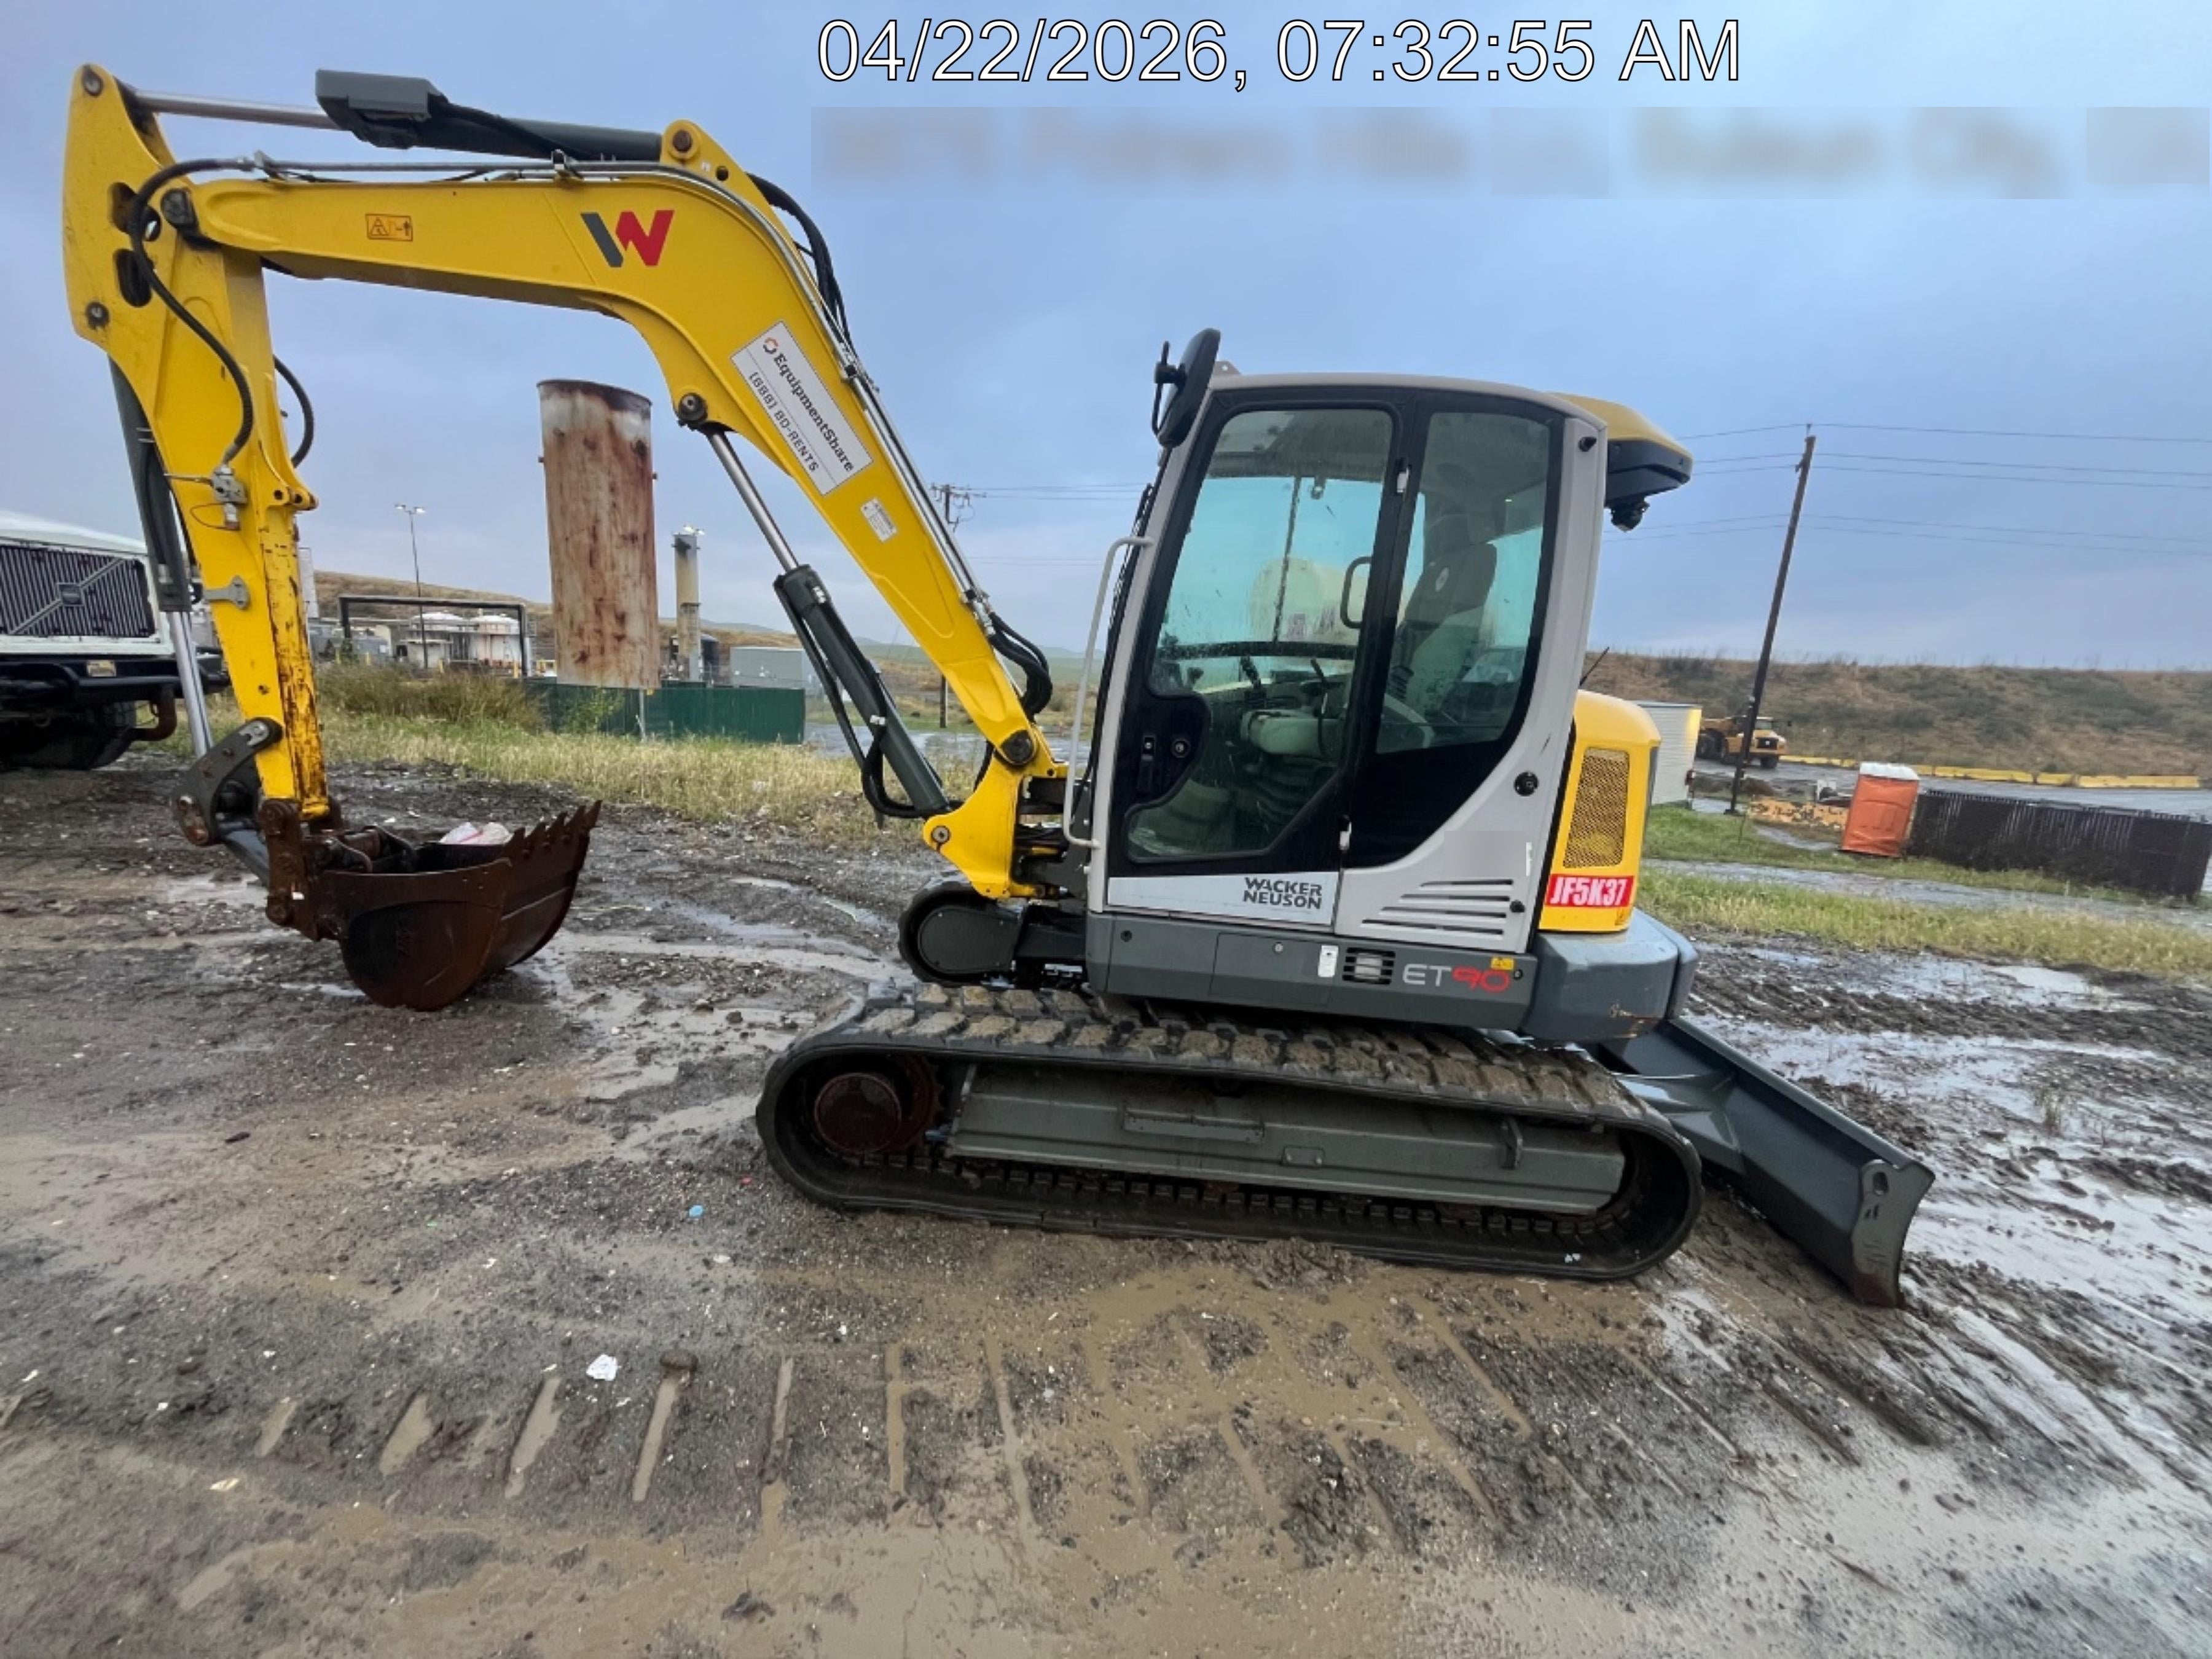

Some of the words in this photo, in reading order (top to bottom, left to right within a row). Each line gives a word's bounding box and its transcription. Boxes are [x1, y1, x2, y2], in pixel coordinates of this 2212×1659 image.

[773, 353, 854, 472] EquipmentShare
[774, 410, 819, 471] 80-RENTS
[1243, 890, 1322, 909] NEUSON
[1244, 876, 1322, 896] WACKER
[1550, 876, 1628, 906] JF5K37
[1402, 963, 1511, 994] ET90
